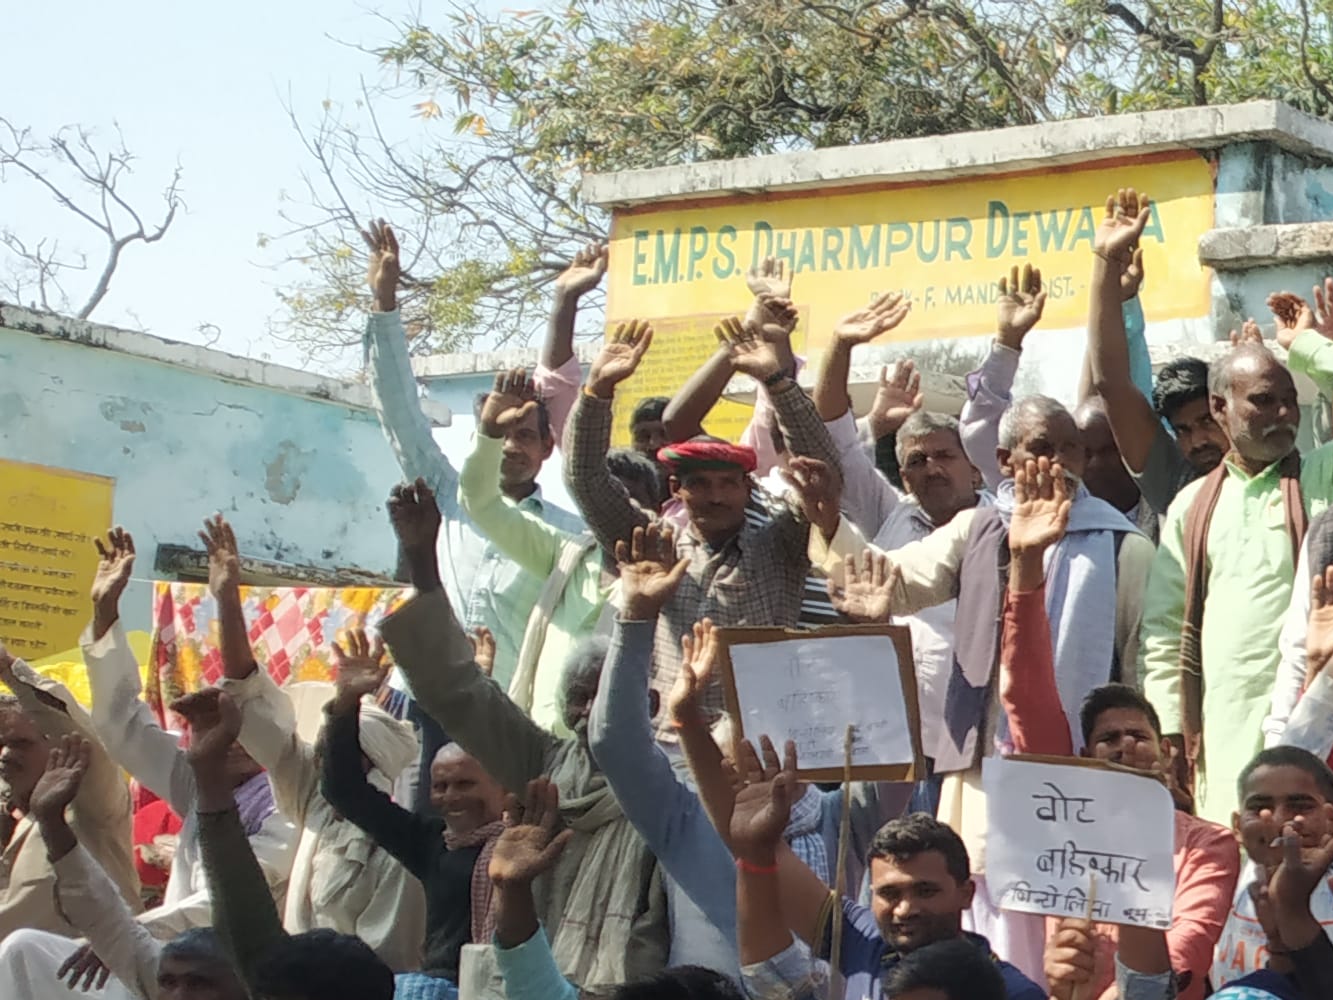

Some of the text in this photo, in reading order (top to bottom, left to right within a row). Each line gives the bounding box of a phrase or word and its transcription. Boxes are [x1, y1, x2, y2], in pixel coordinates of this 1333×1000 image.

[632, 199, 1165, 286] E.M.P.S. DHARMPUR DEWAA
[1032, 782, 1095, 823] वोट
